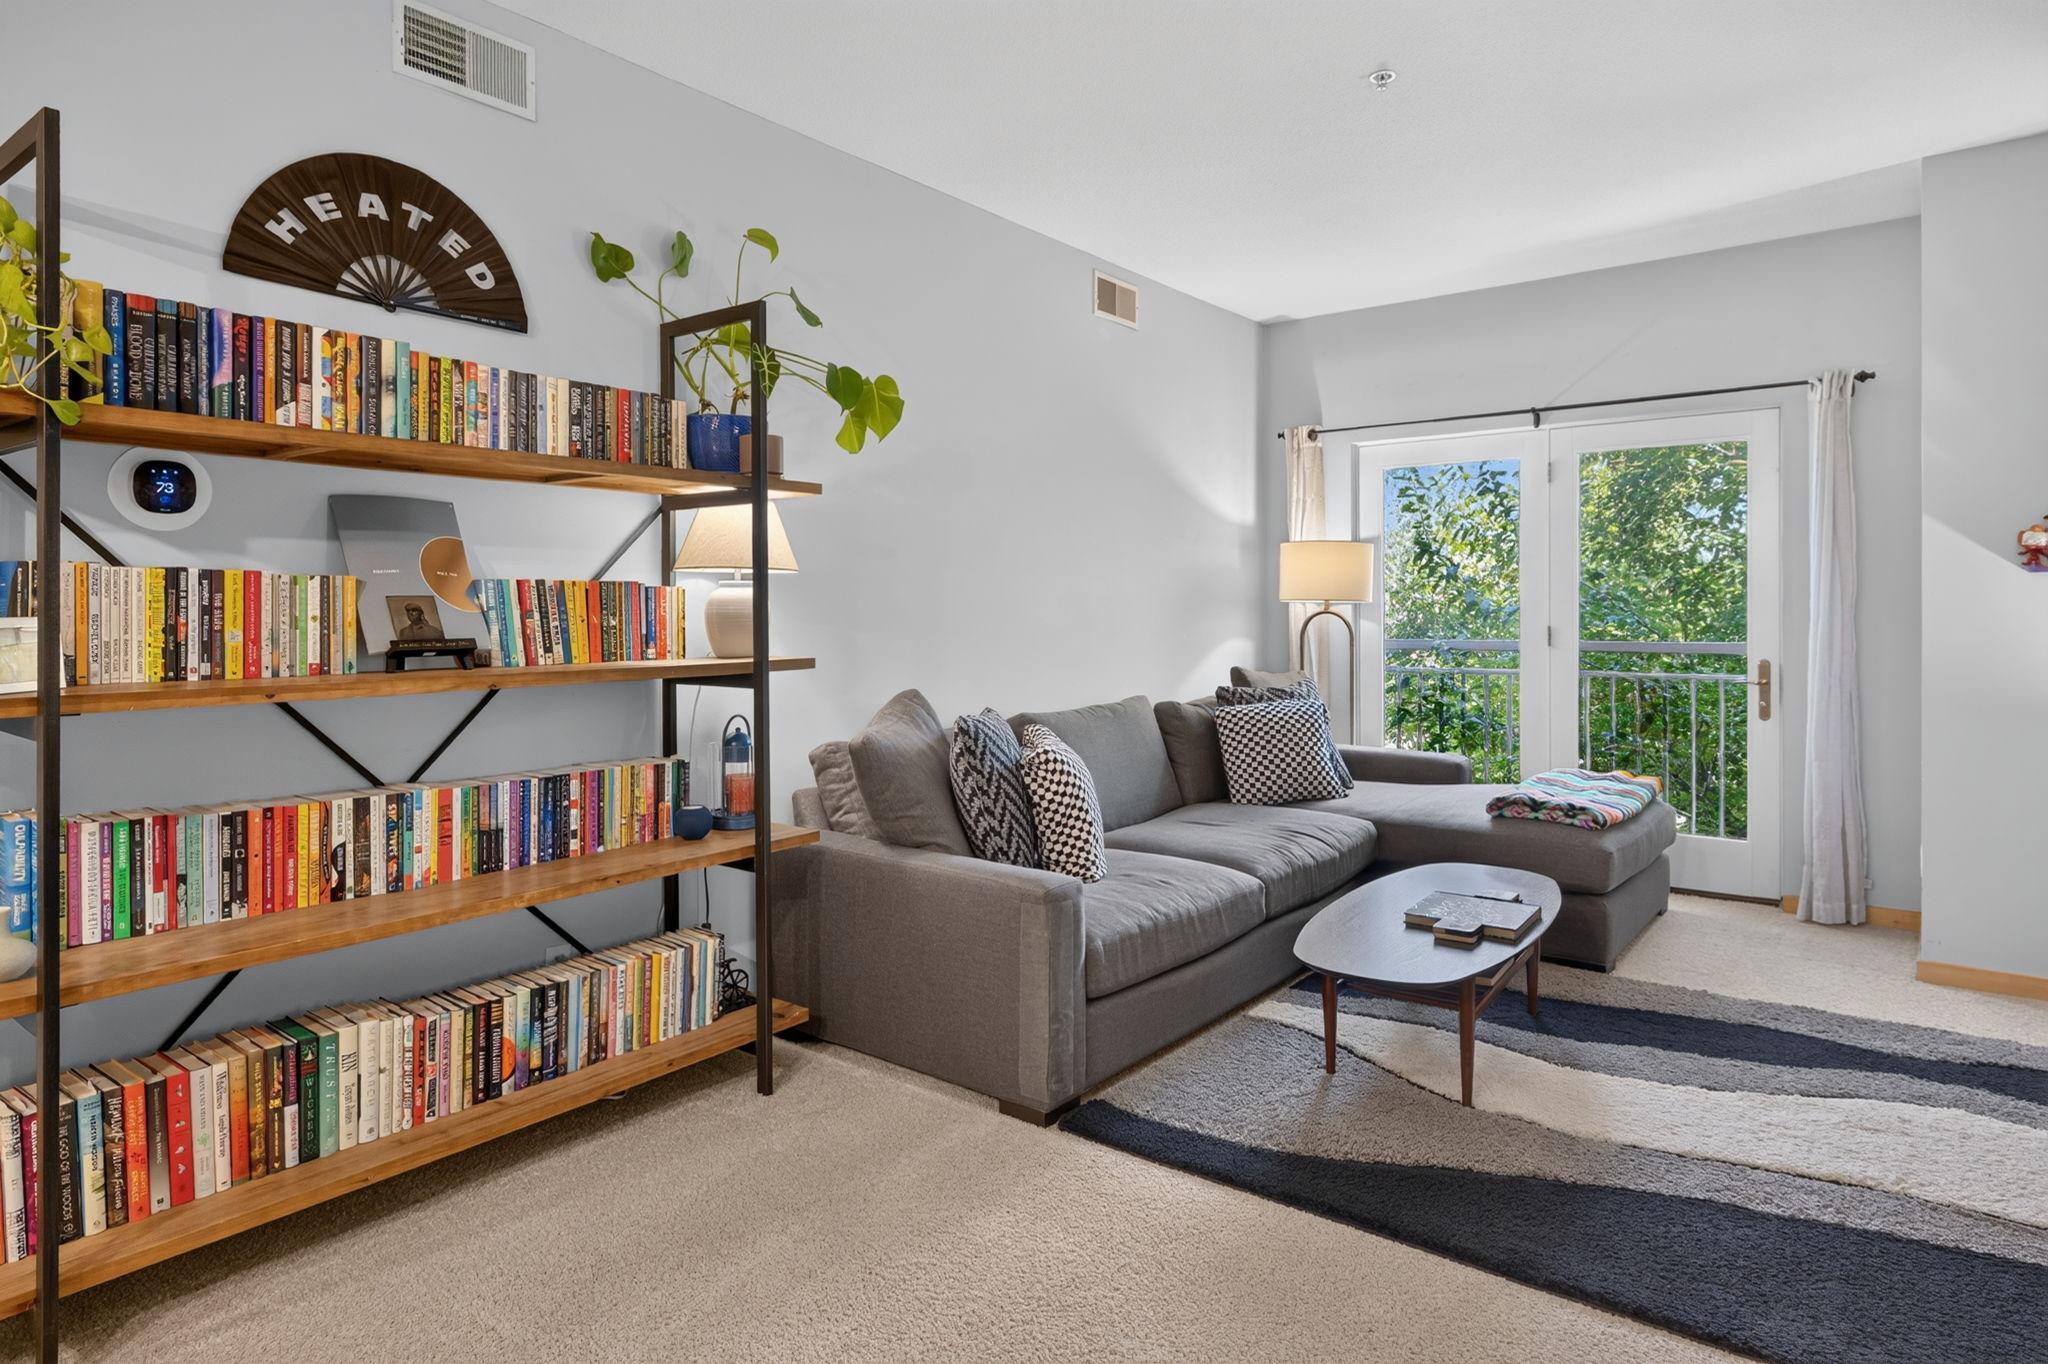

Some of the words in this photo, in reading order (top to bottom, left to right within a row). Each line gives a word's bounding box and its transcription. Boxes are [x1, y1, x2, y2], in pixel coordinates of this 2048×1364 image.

[264, 191, 496, 291] HEATED
[129, 324, 143, 359] BLOOD
[129, 370, 143, 400] BONE
[155, 481, 174, 494] 73
[326, 1043, 336, 1100] TRUST
[341, 1051, 357, 1073] KIN
[60, 1139, 70, 1160] GOD
[62, 1185, 72, 1220] WOODS
